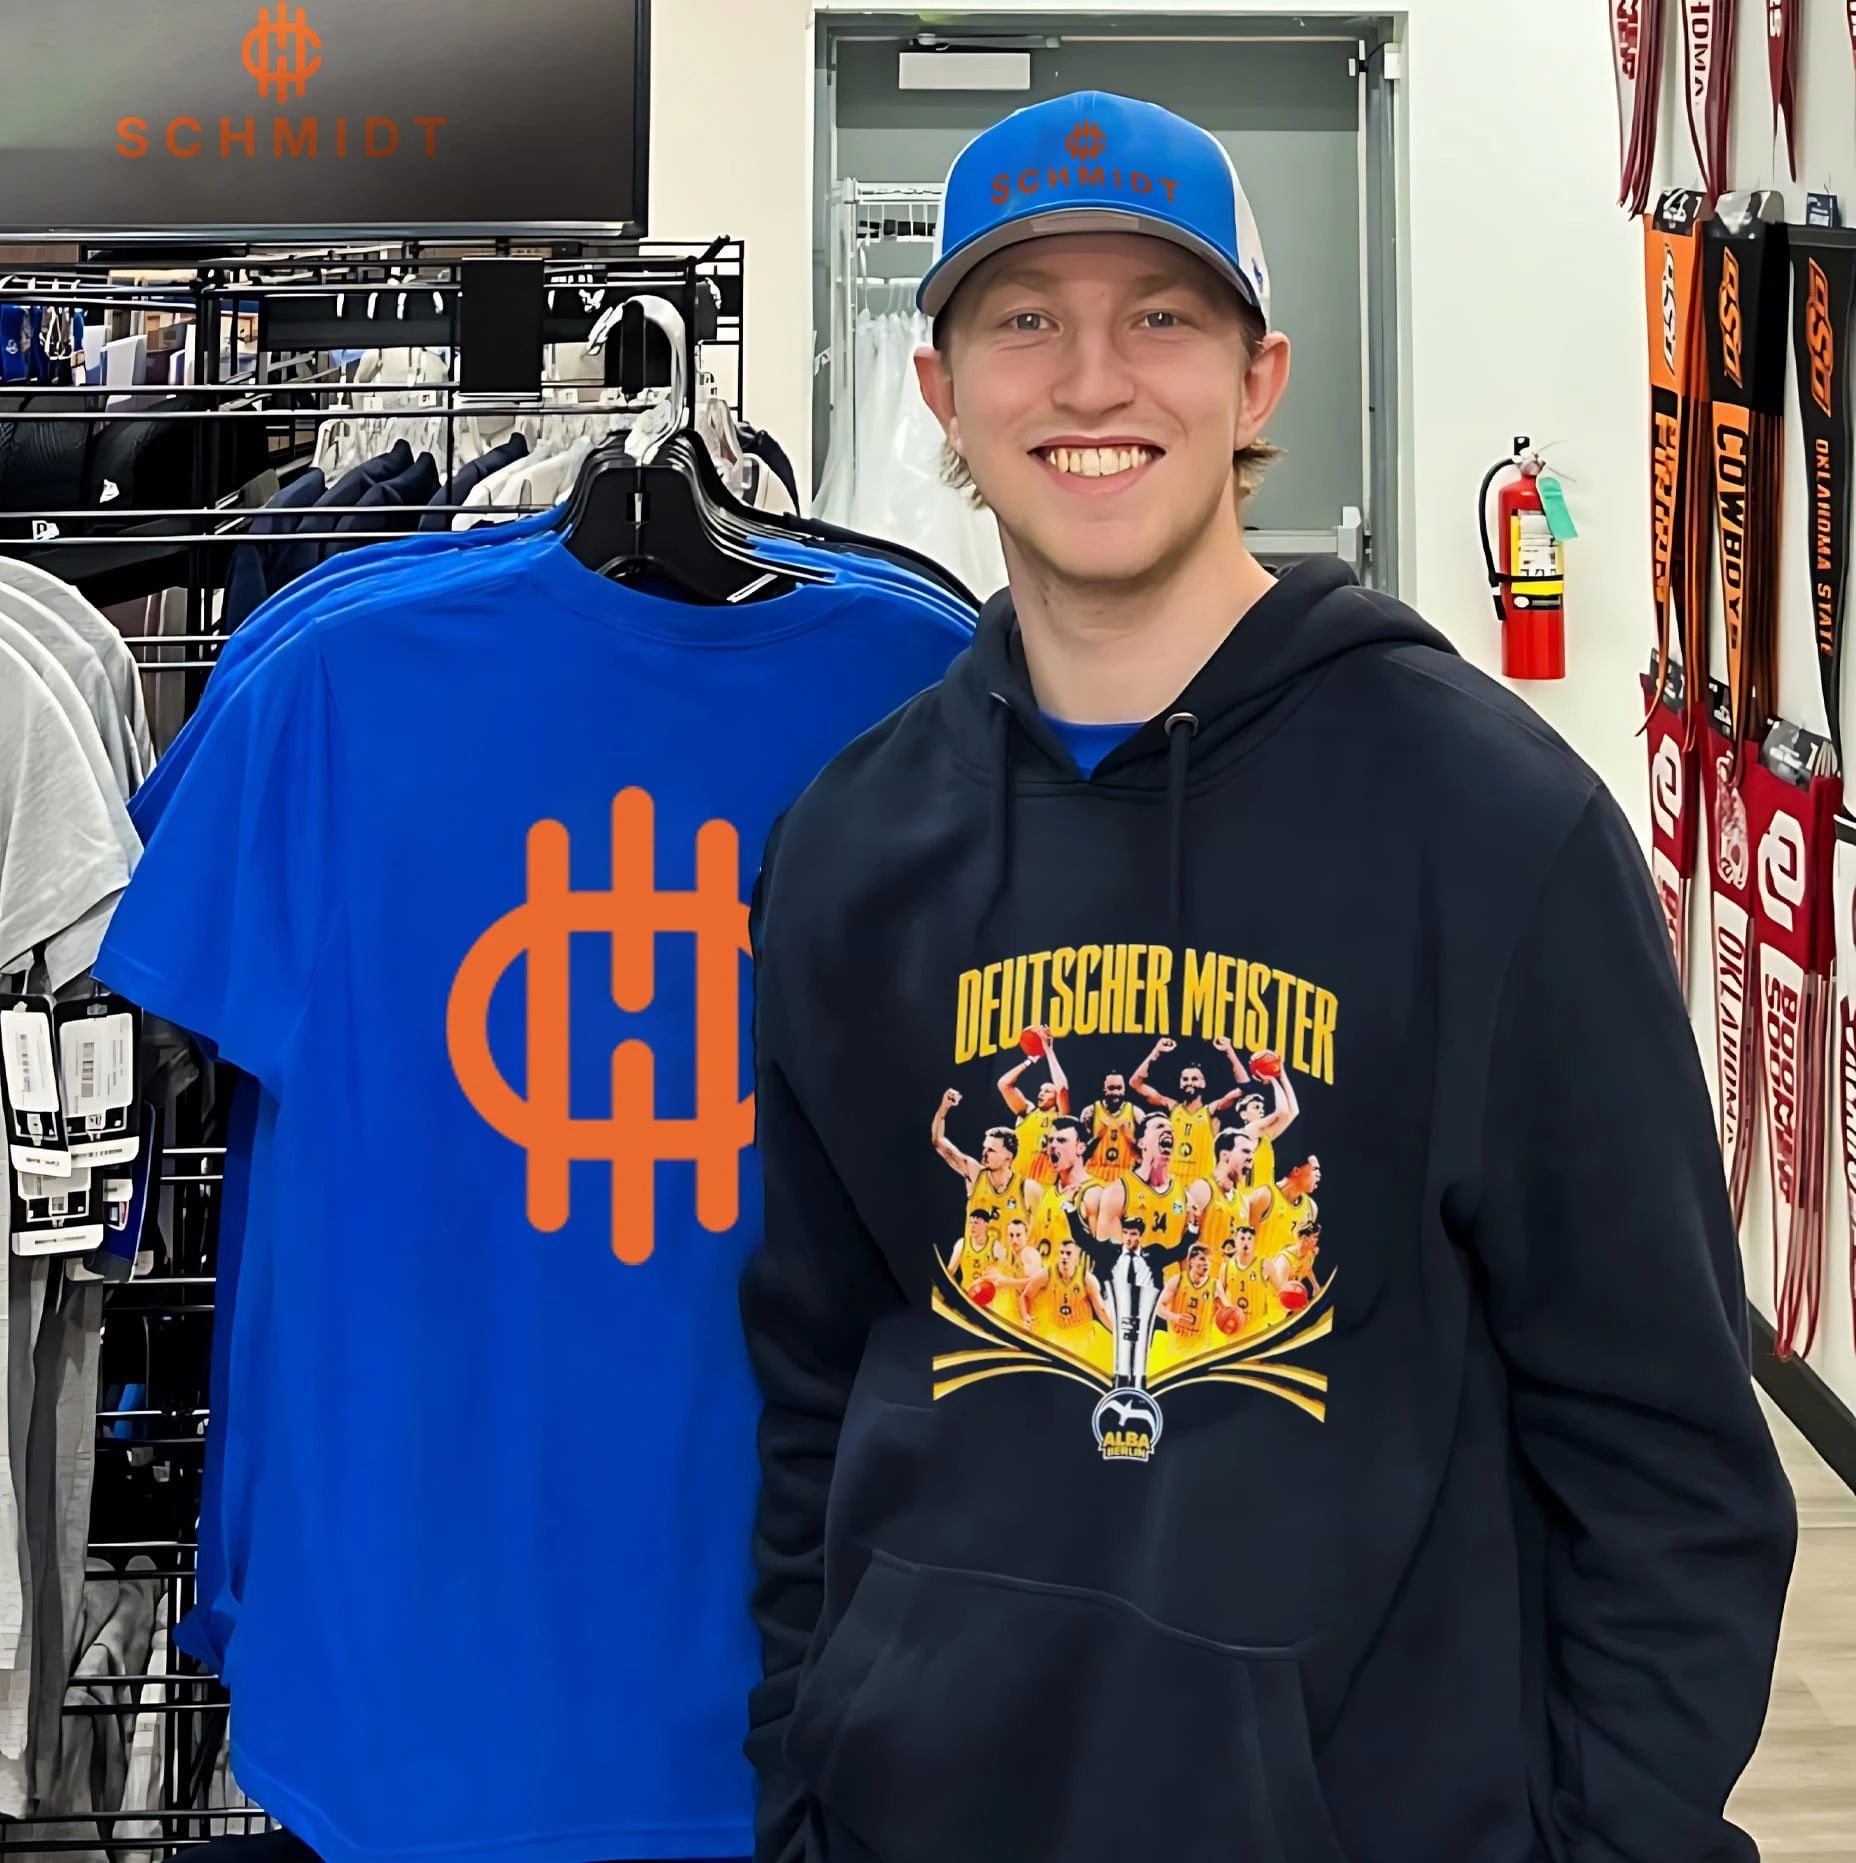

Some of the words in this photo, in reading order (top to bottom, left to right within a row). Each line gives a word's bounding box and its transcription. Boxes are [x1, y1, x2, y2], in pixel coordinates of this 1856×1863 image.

[116, 116, 447, 159] SCHMIDT
[991, 167, 1181, 204] SCHMIDT
[1816, 438, 1832, 570] OKLAHOMA
[955, 944, 1172, 1064] DEUTSCHER
[1181, 947, 1339, 1085] MEISTER
[1718, 926, 1745, 1144] OKLAHOMA
[1103, 1431, 1150, 1447] ALBA
[1106, 1446, 1147, 1458] BERLIN
